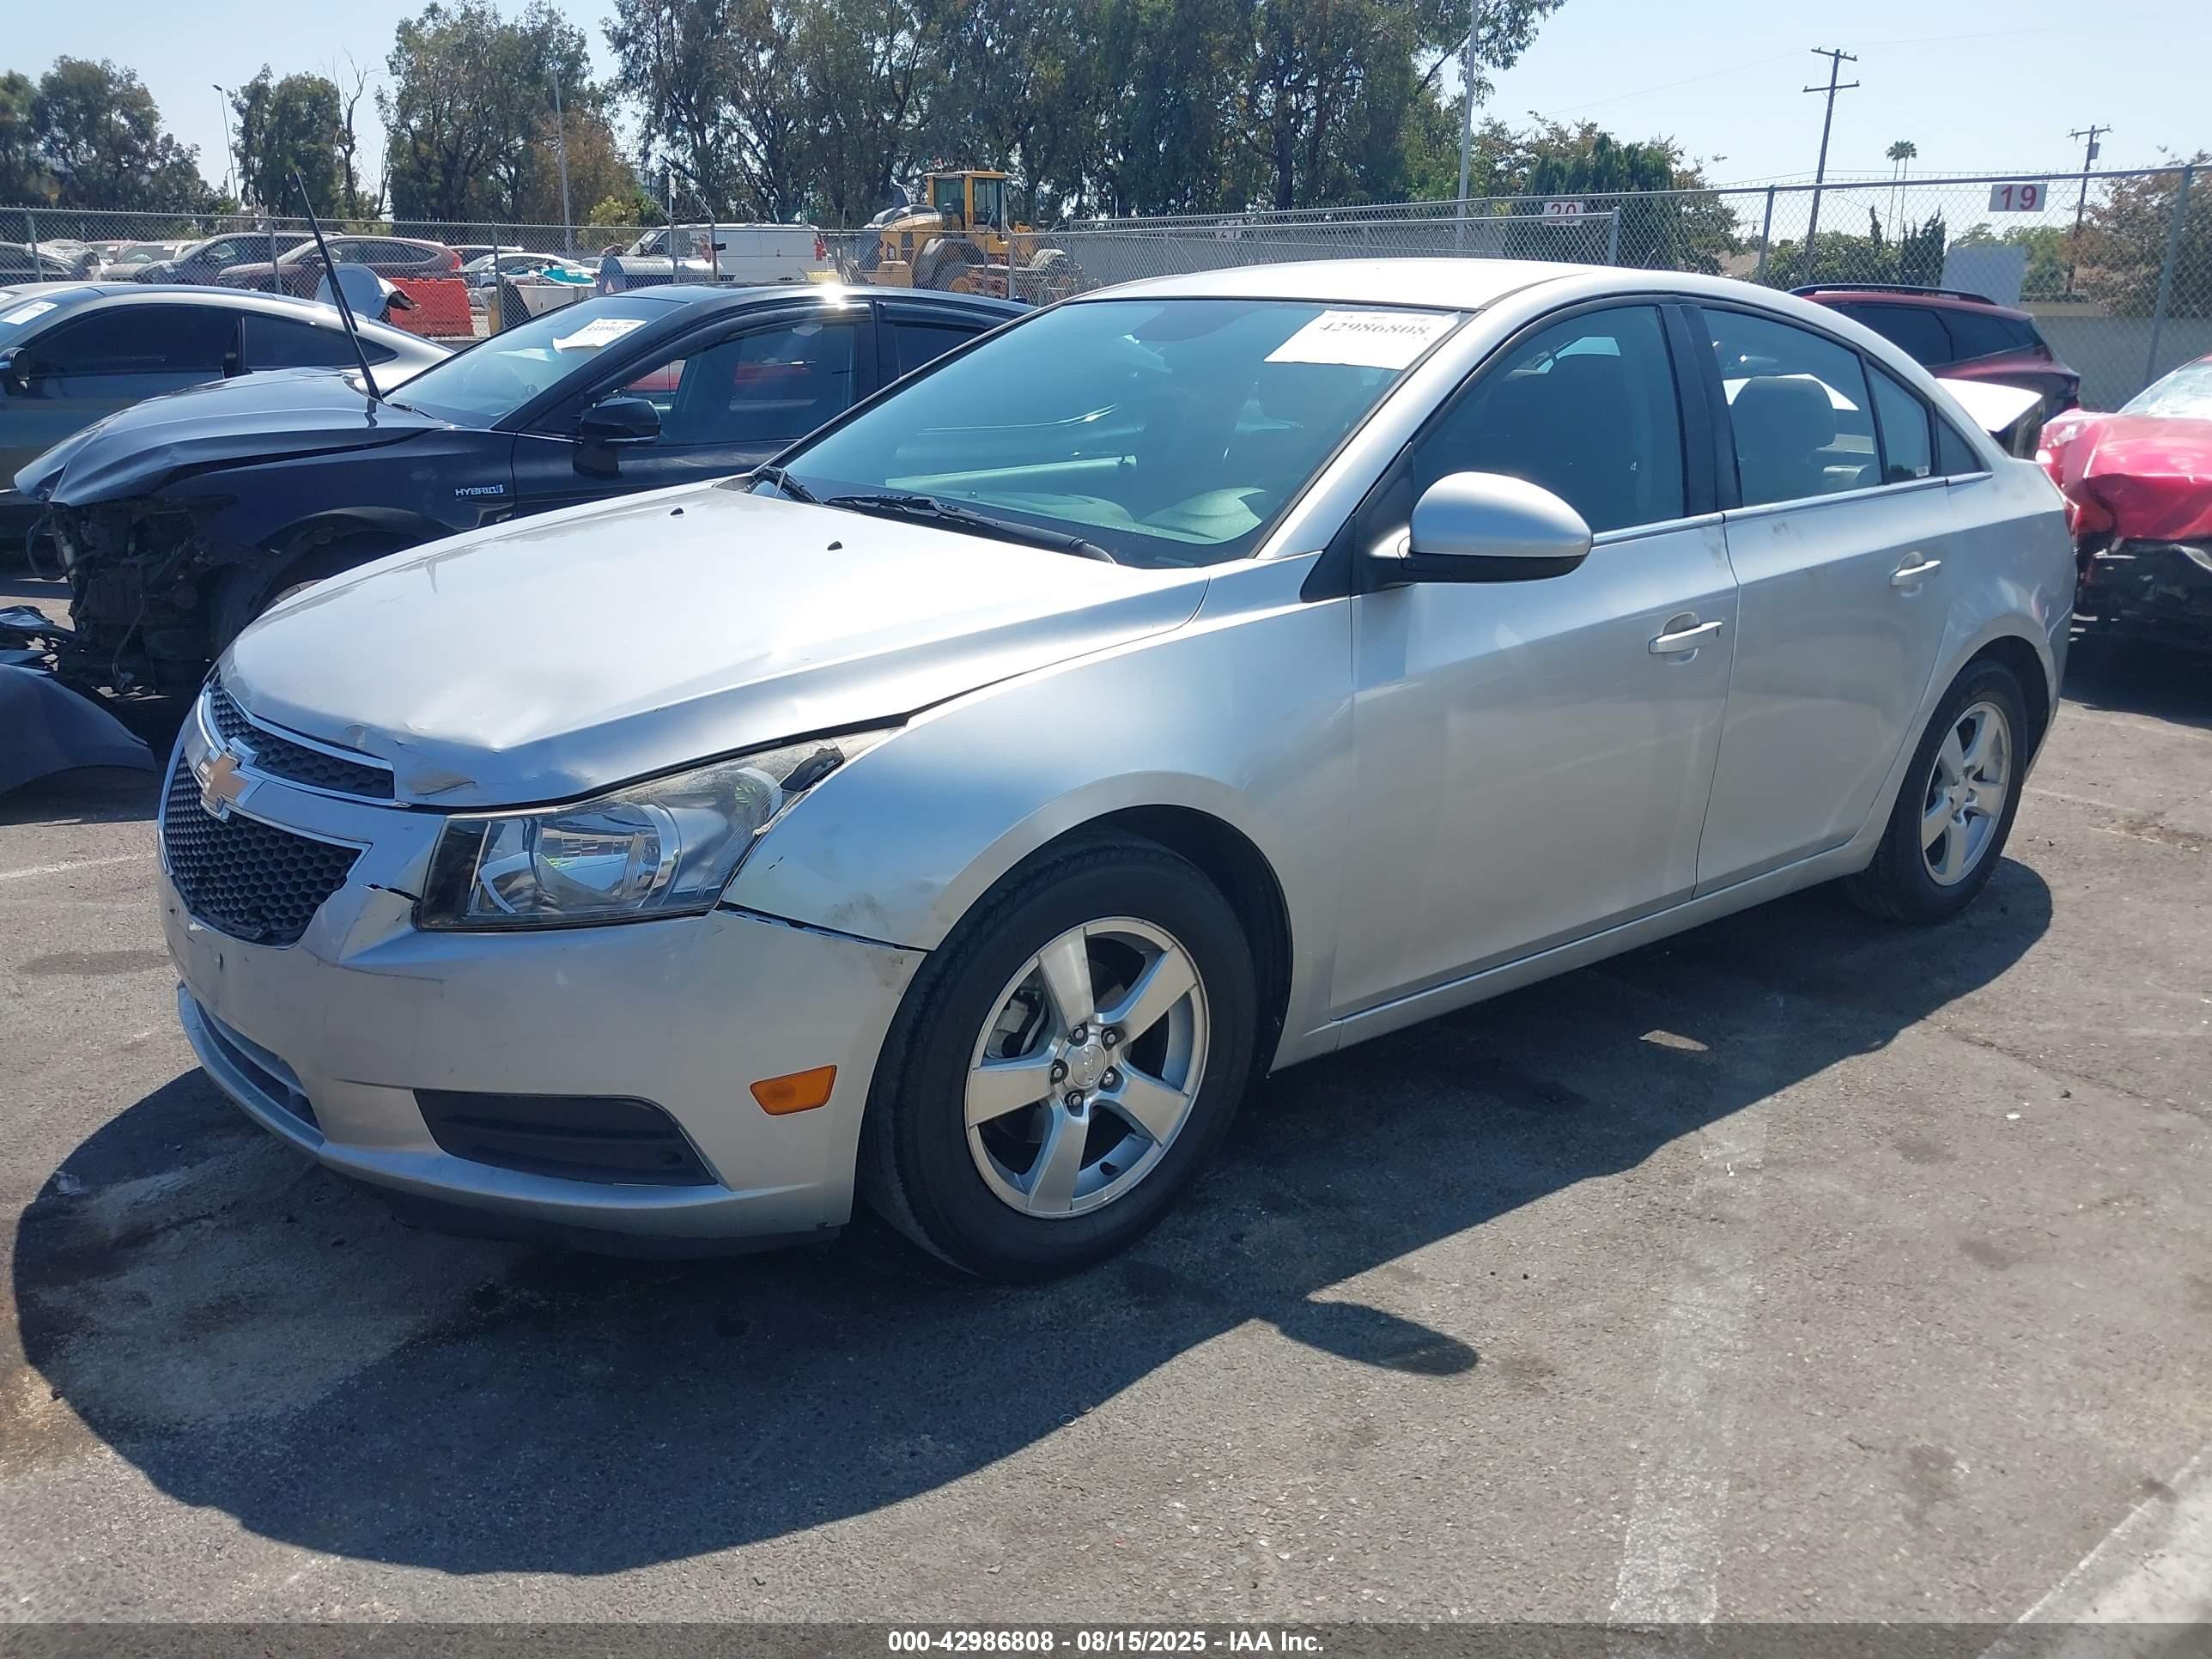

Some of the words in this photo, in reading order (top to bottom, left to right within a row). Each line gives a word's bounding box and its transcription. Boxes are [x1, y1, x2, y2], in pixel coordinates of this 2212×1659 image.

[2001, 185, 2037, 210] 19
[1549, 203, 1577, 224] 20
[1319, 322, 1431, 335] 42986808
[454, 486, 496, 495] HYBRID
